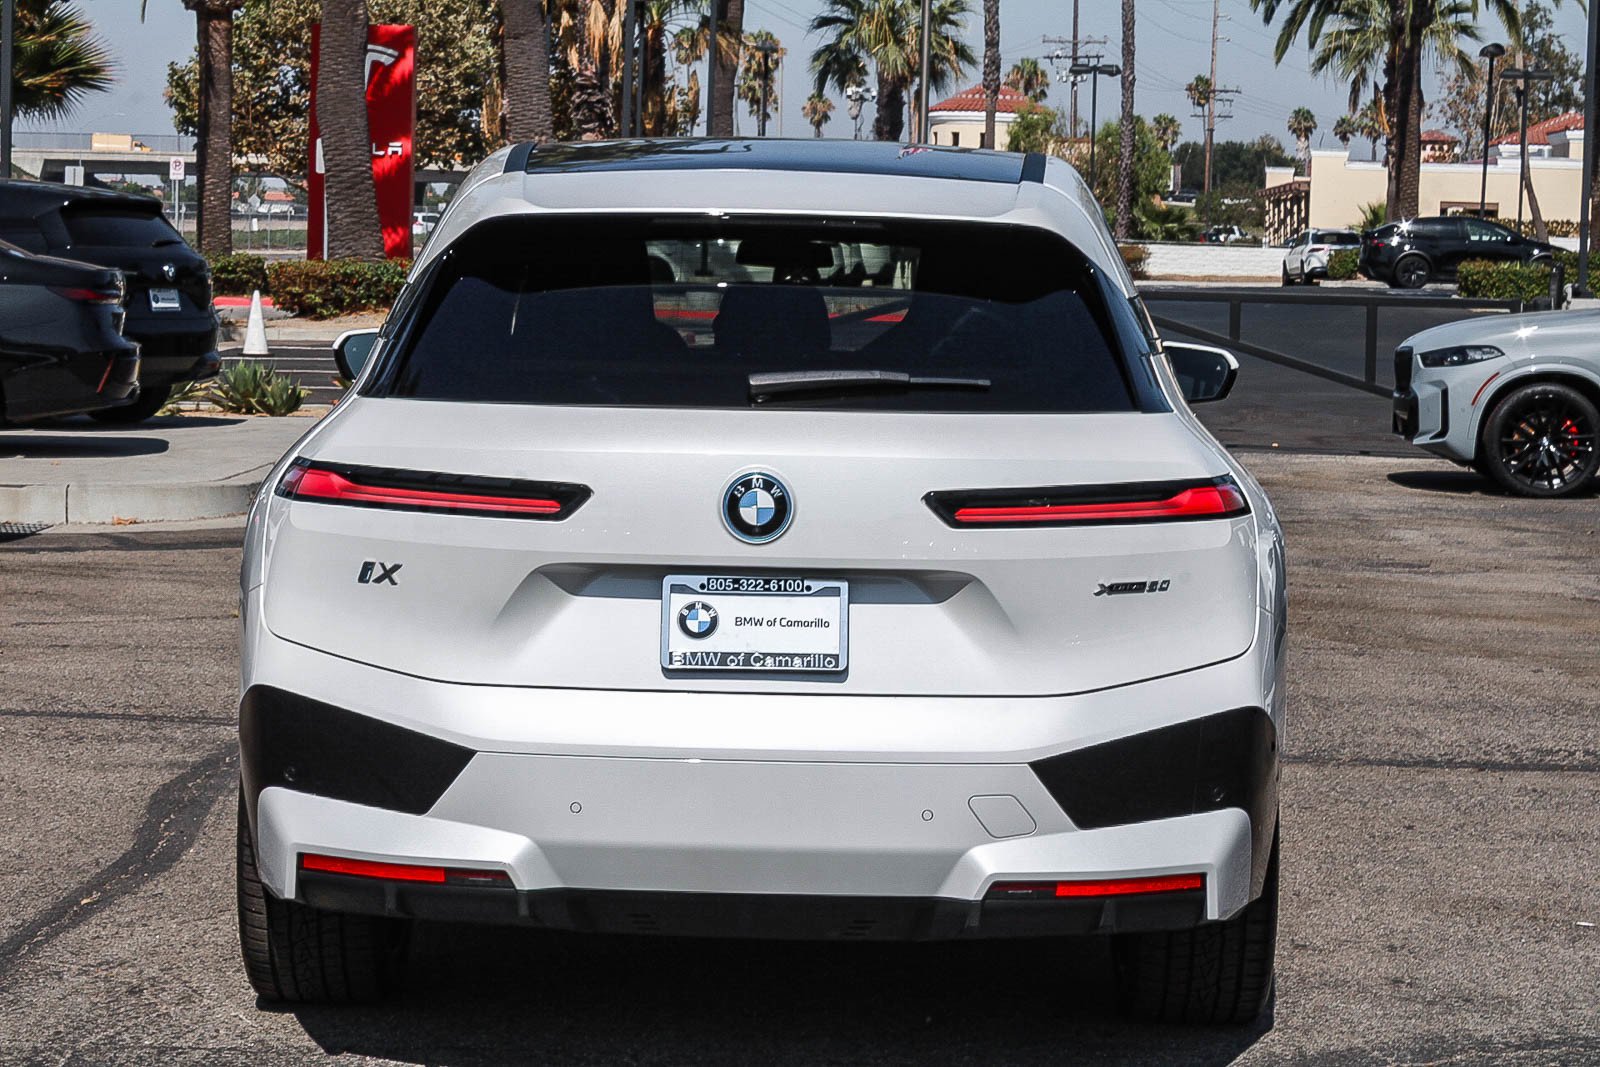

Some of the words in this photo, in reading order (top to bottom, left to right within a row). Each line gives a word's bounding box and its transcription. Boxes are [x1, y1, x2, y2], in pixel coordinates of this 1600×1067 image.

[734, 478, 783, 498] BMW
[708, 579, 803, 592] 805-322-6100
[681, 602, 718, 618] BMW
[735, 616, 764, 627] BMW
[766, 617, 778, 628] of
[779, 617, 830, 629] Camarillo
[672, 652, 721, 666] BMW
[727, 653, 745, 666] of
[750, 652, 836, 668] Camarillo
